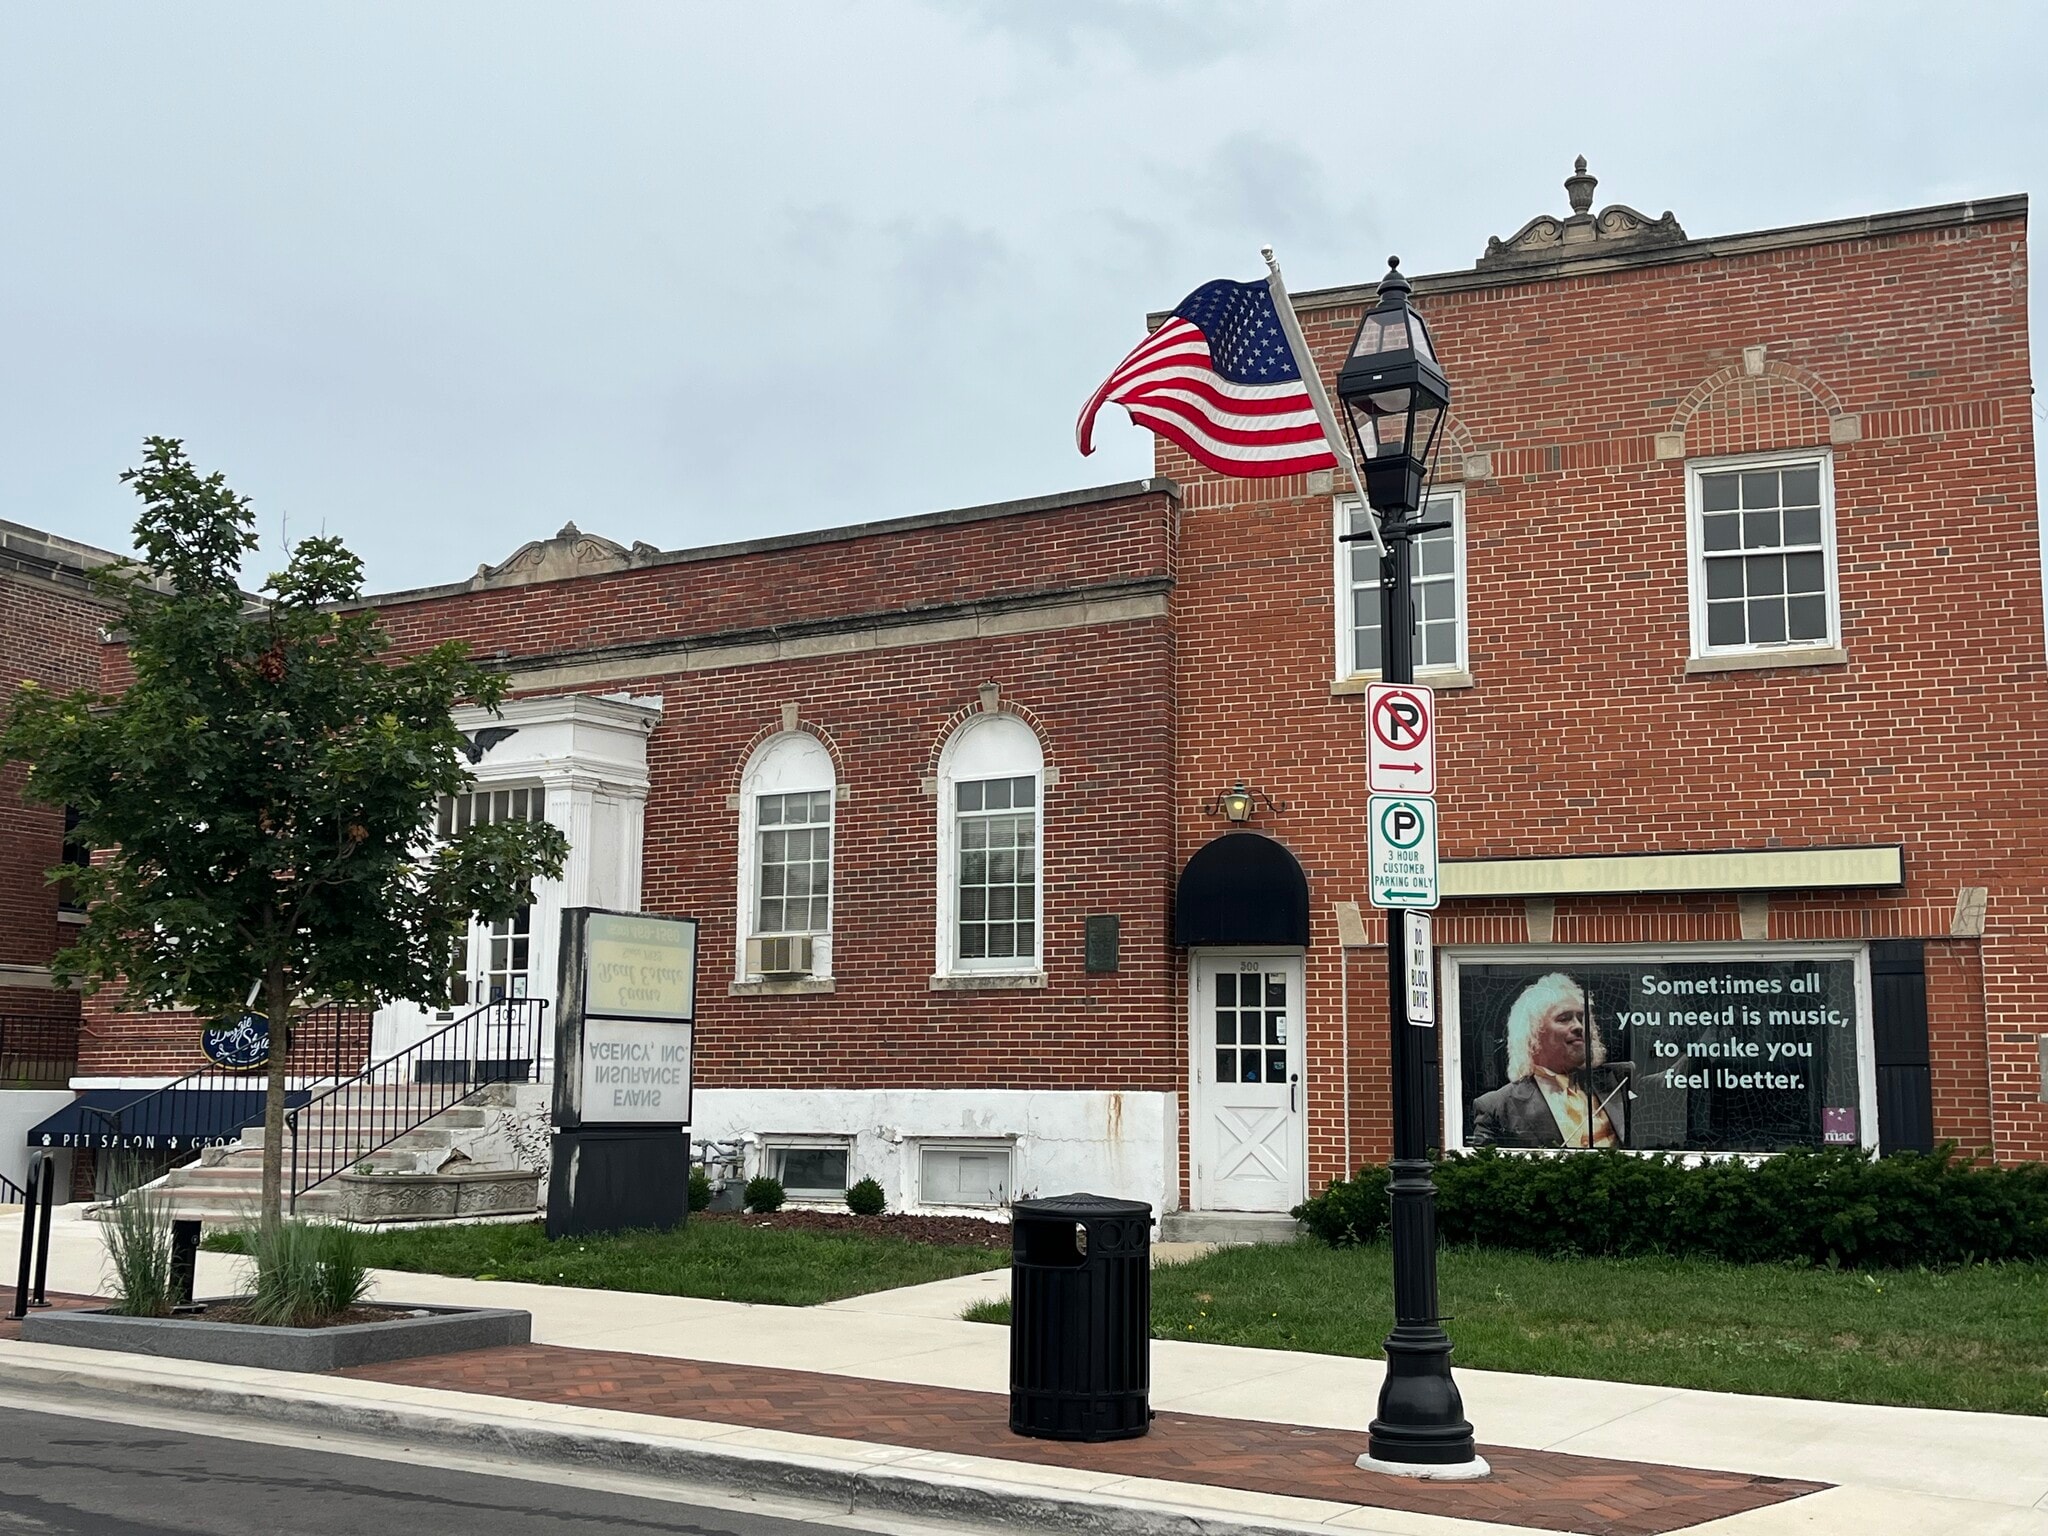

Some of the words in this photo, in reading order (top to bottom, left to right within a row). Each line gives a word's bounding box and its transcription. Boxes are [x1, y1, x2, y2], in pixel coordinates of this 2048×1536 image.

[1394, 811, 1416, 840] P
[1388, 850, 1393, 860] 3
[1397, 851, 1419, 861] HOUR
[1383, 863, 1425, 874] CUSTOMER
[1375, 876, 1409, 887] PARKING
[1413, 878, 1433, 888] ONLY
[1414, 928, 1422, 945] DO
[1413, 949, 1424, 966] NOT
[1411, 969, 1428, 988] BLOCK
[1641, 974, 1782, 994] Sometimes
[1789, 972, 1820, 993] all
[1412, 990, 1428, 1008] DRIVE
[1616, 1011, 1660, 1030] you
[1669, 1005, 1734, 1026] need
[1742, 1005, 1761, 1025] is
[1769, 1004, 1849, 1028] music,
[1653, 1039, 1679, 1057] to
[1686, 1036, 1759, 1057] make
[1766, 1041, 1813, 1061] you
[1665, 1068, 1709, 1089] feel
[1718, 1068, 1805, 1090] better.
[62, 1133, 90, 1147] PET
[101, 1134, 155, 1149] SALON
[1824, 1132, 1854, 1141] mac
